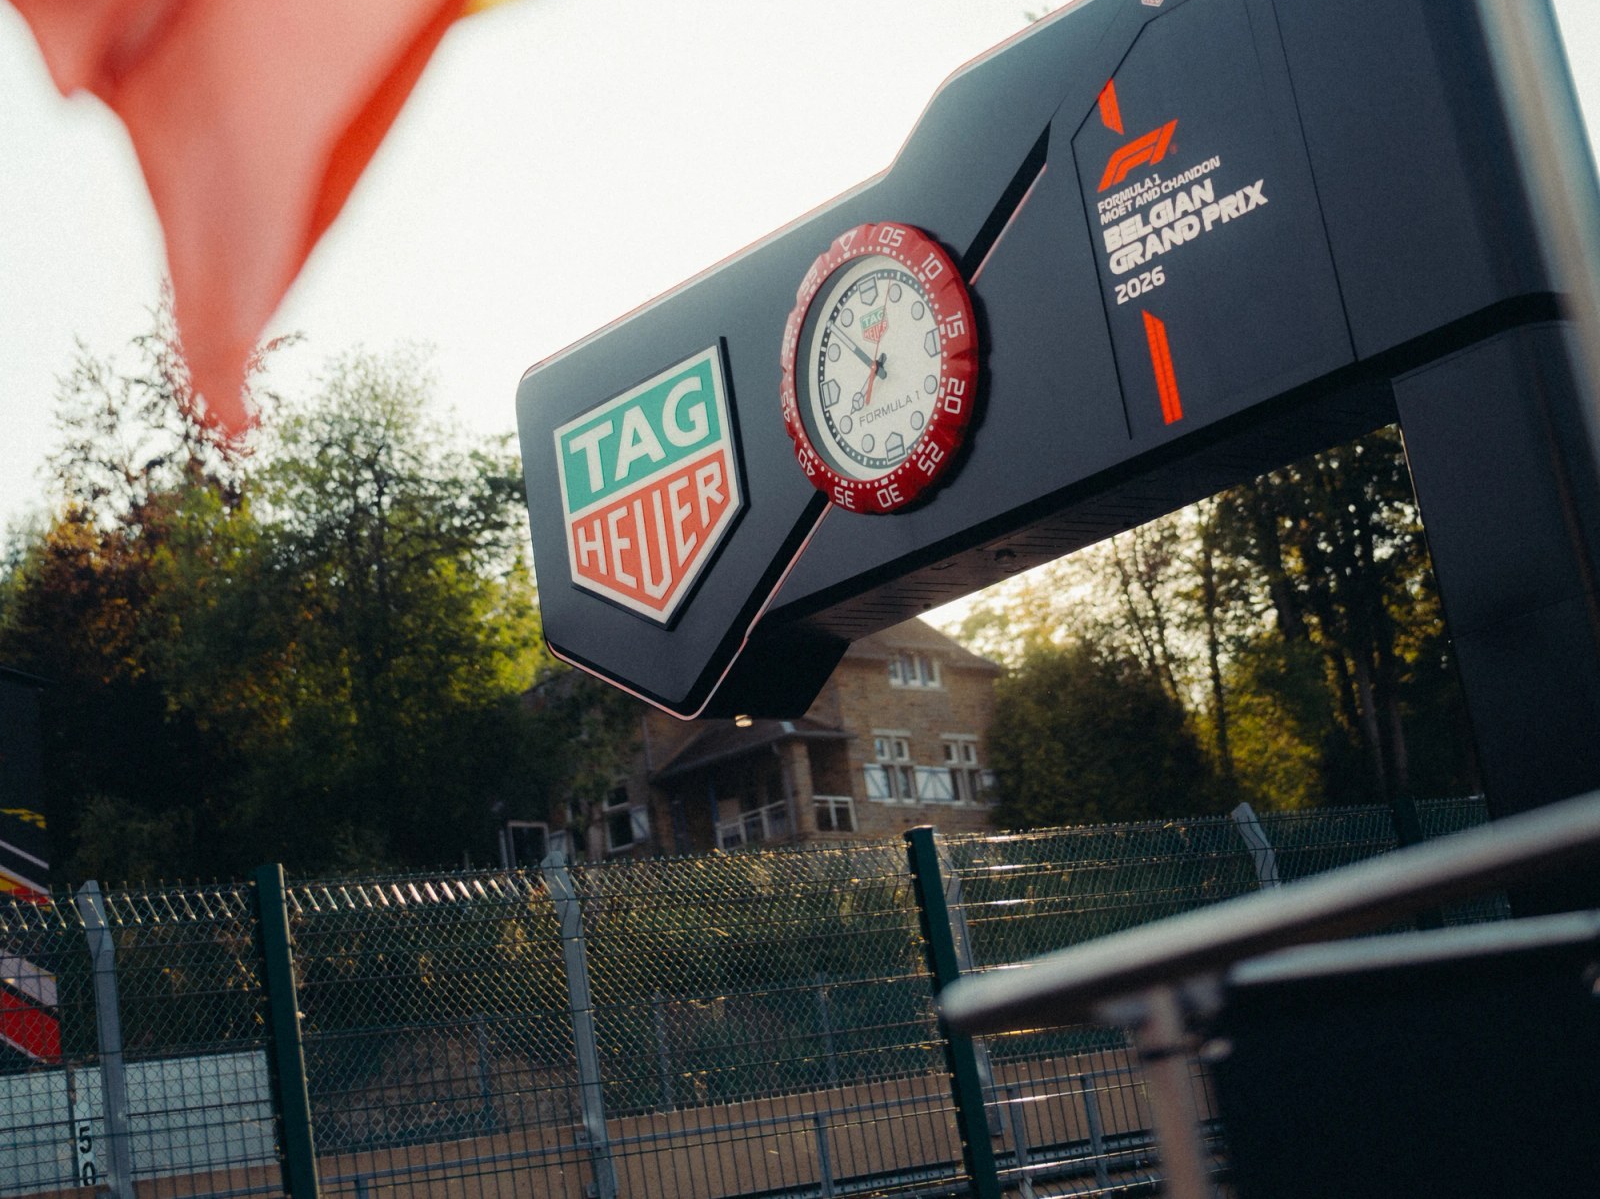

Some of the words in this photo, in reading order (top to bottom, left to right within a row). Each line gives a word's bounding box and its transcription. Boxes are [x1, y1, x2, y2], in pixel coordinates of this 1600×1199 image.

[1097, 179, 1154, 214] FORMULA
[1152, 173, 1162, 188] 1
[1100, 200, 1133, 226] MOET
[1135, 187, 1161, 209] AND
[1162, 155, 1221, 194] CHANDON
[1103, 178, 1215, 253] BELGIAN
[1109, 214, 1201, 275] GRAND
[1201, 179, 1269, 232] PRIX
[878, 226, 906, 247] 05
[921, 252, 943, 281] 10
[1114, 265, 1166, 305] 2026
[945, 311, 965, 339] 15
[859, 394, 913, 427] FORMULA
[915, 389, 920, 401] 1
[944, 377, 966, 414] 20
[569, 376, 710, 494] TAG
[798, 448, 816, 476] 40
[917, 441, 944, 476] 25
[834, 486, 855, 509] 35
[877, 483, 904, 508] 30
[577, 461, 726, 599] HEUER
